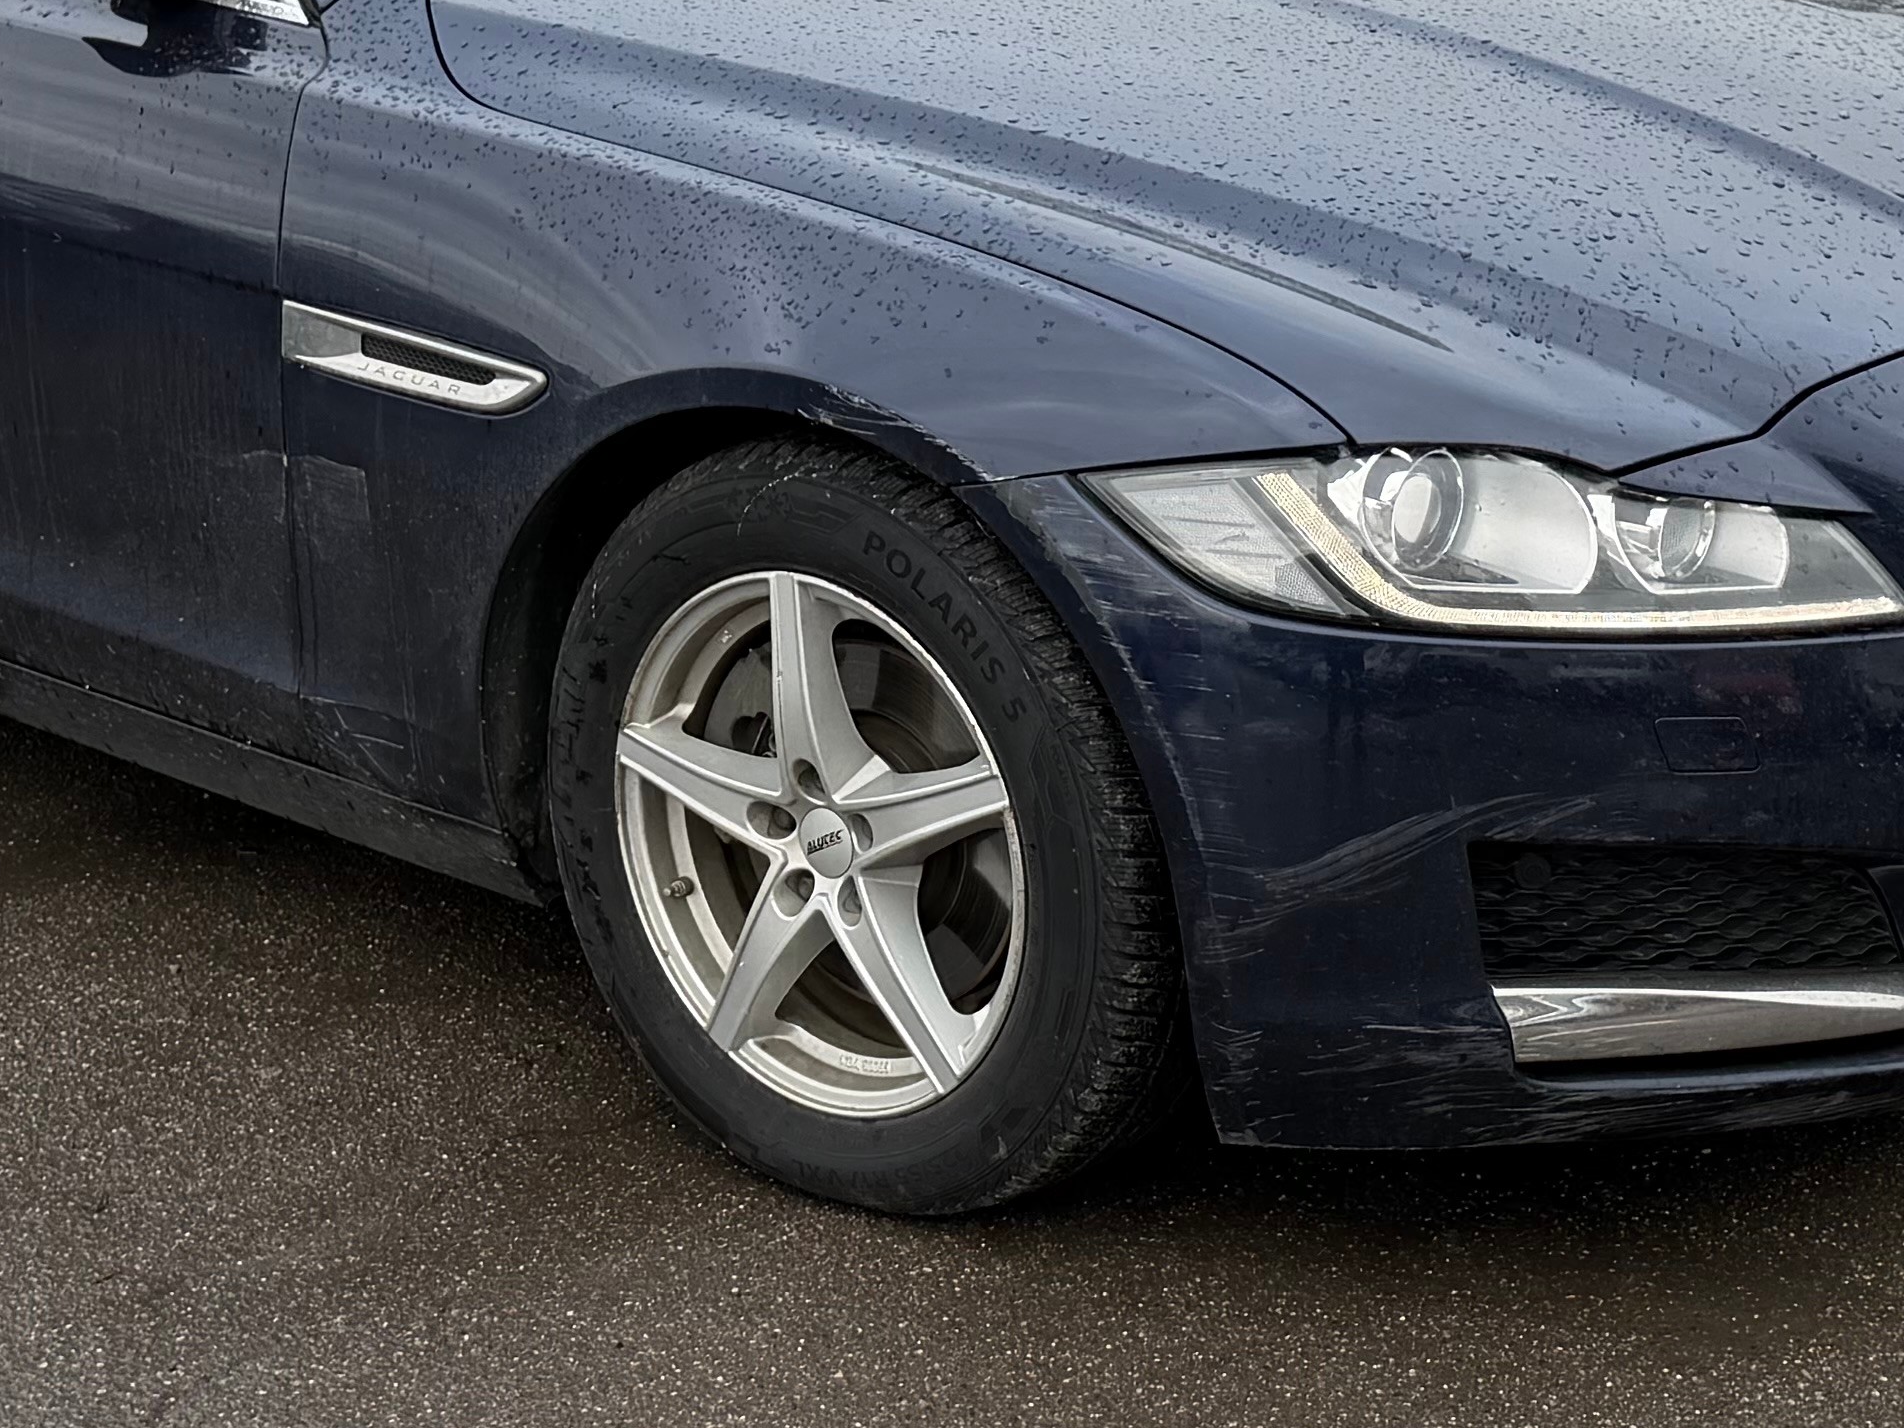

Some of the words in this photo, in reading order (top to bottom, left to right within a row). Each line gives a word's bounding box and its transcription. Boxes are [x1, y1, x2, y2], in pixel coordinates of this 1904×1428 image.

[357, 362, 461, 396] JAGUAR
[863, 530, 1005, 685] POLARIS
[1002, 696, 1027, 723] 5
[807, 829, 845, 853] ALUTEC
